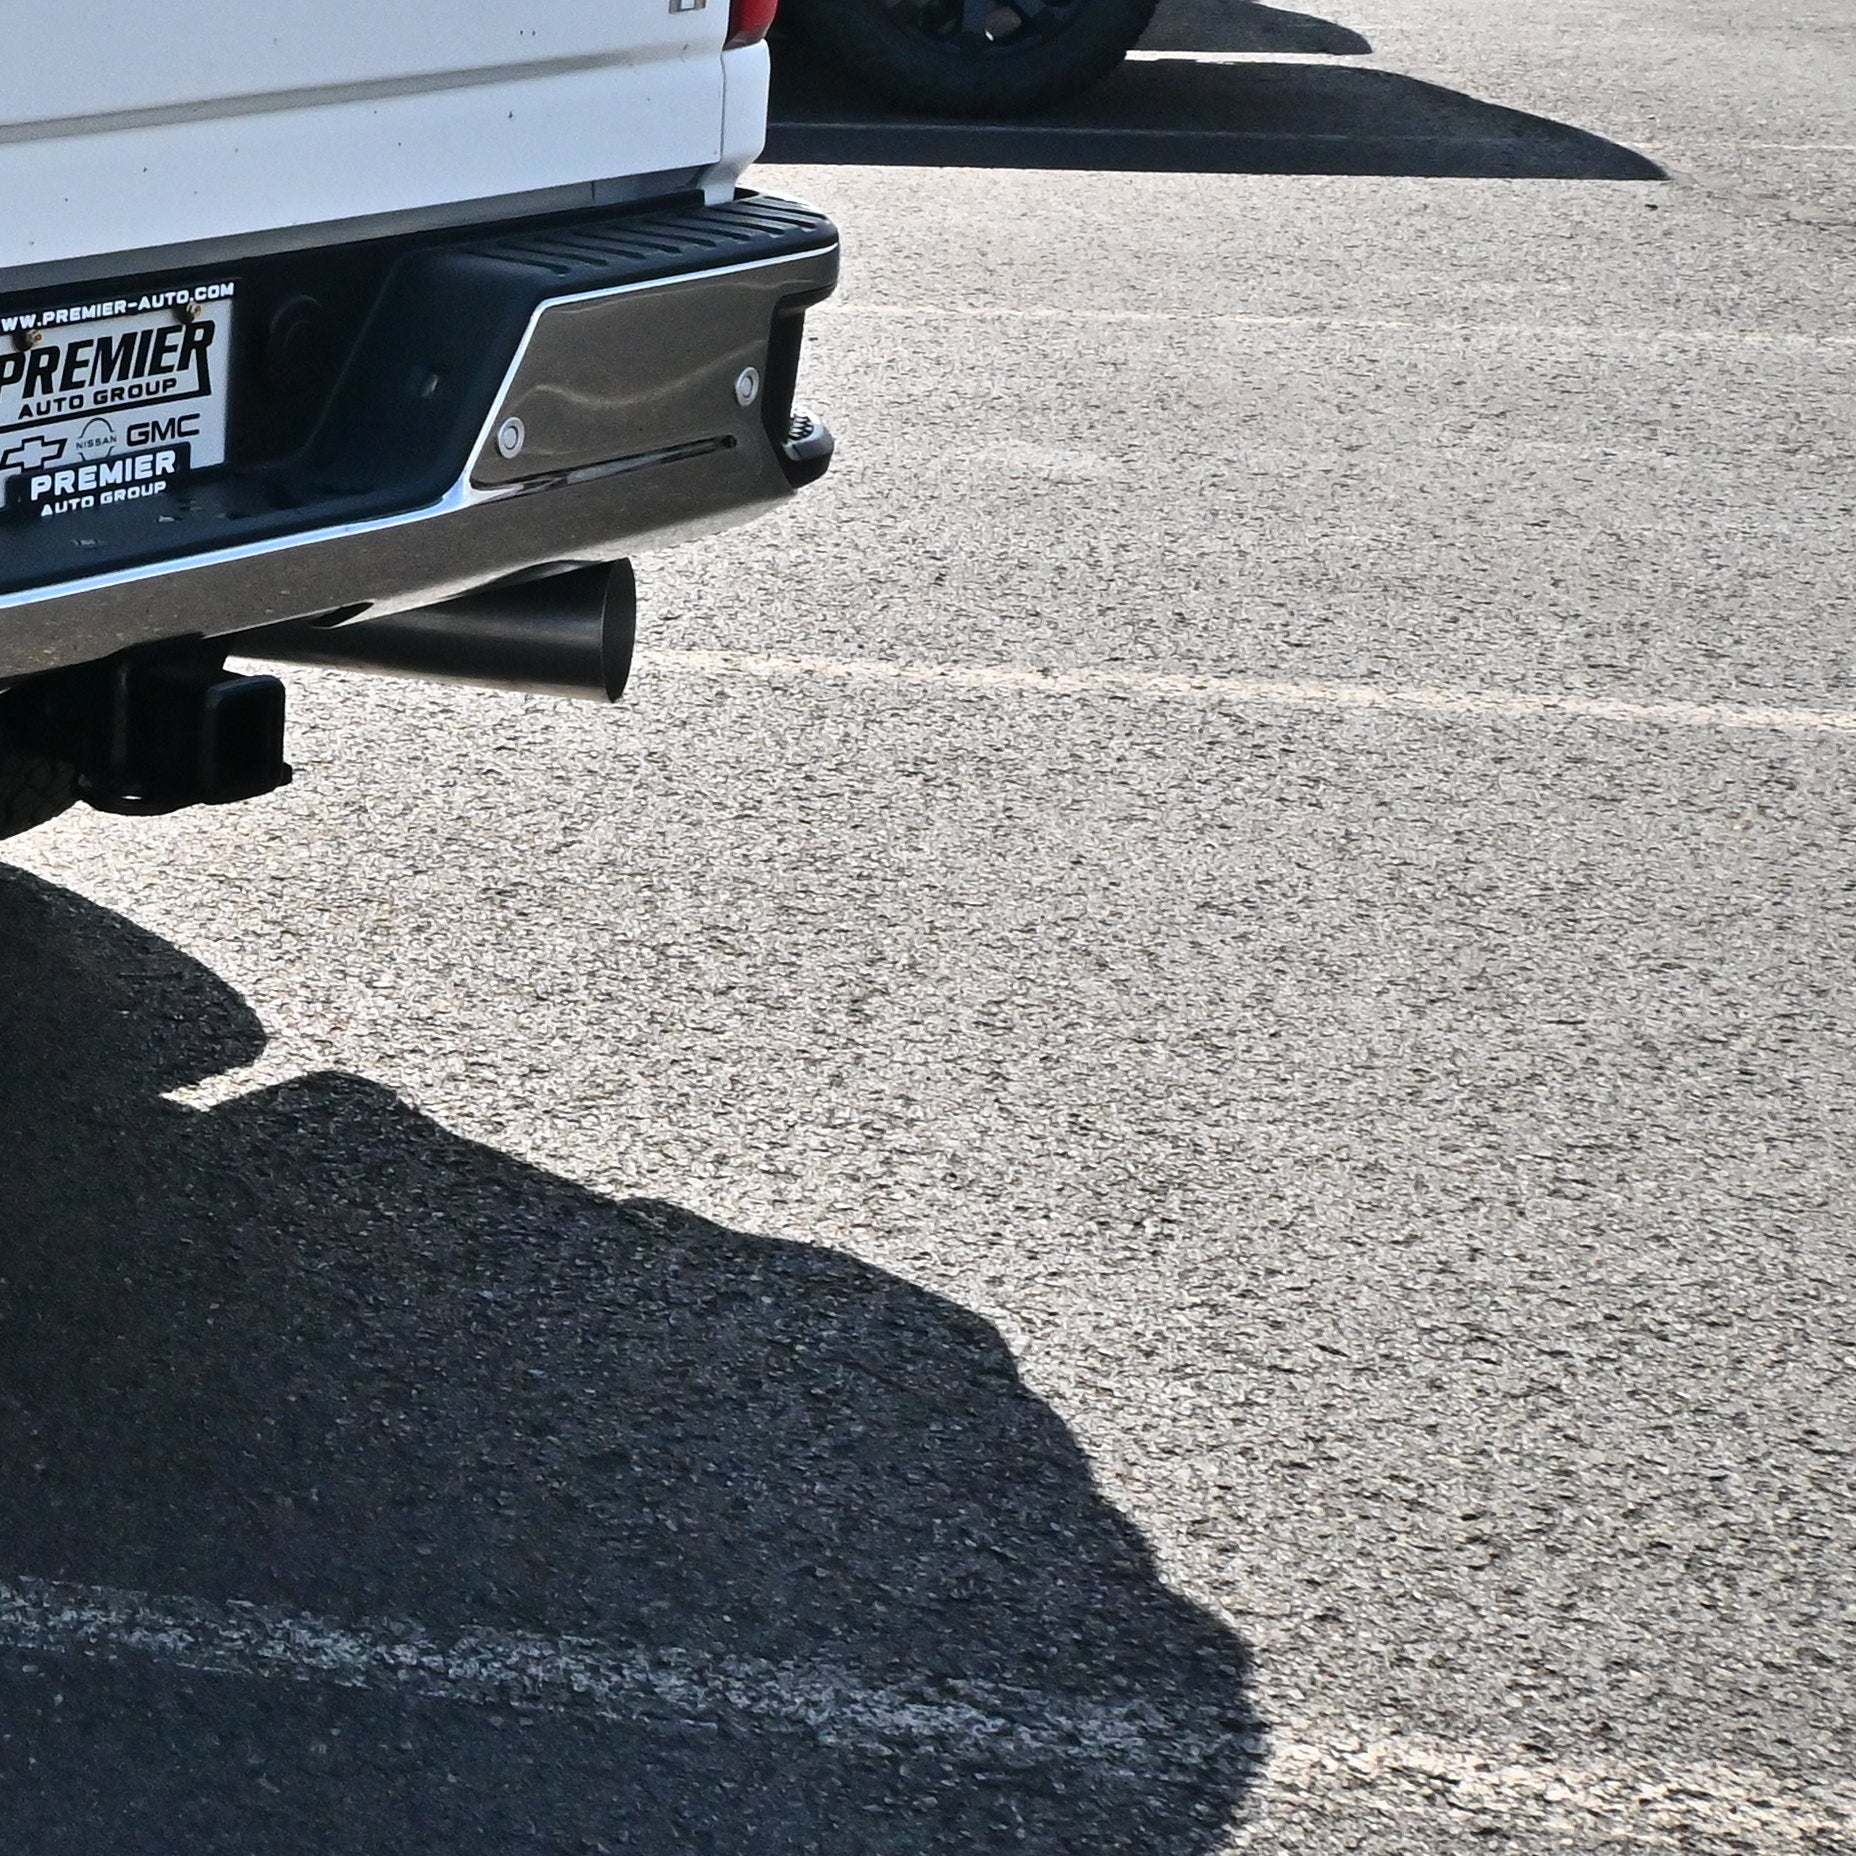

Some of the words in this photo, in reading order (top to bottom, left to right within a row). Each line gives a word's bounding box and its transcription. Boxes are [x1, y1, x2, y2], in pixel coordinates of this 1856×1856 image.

[18, 393, 84, 420] AUTO
[93, 377, 178, 406] GROUP
[75, 434, 118, 450] NISSAN
[126, 413, 201, 447] GMC
[30, 449, 177, 502] PREMIER
[40, 495, 95, 517] AUTO
[100, 480, 167, 505] GROUP
